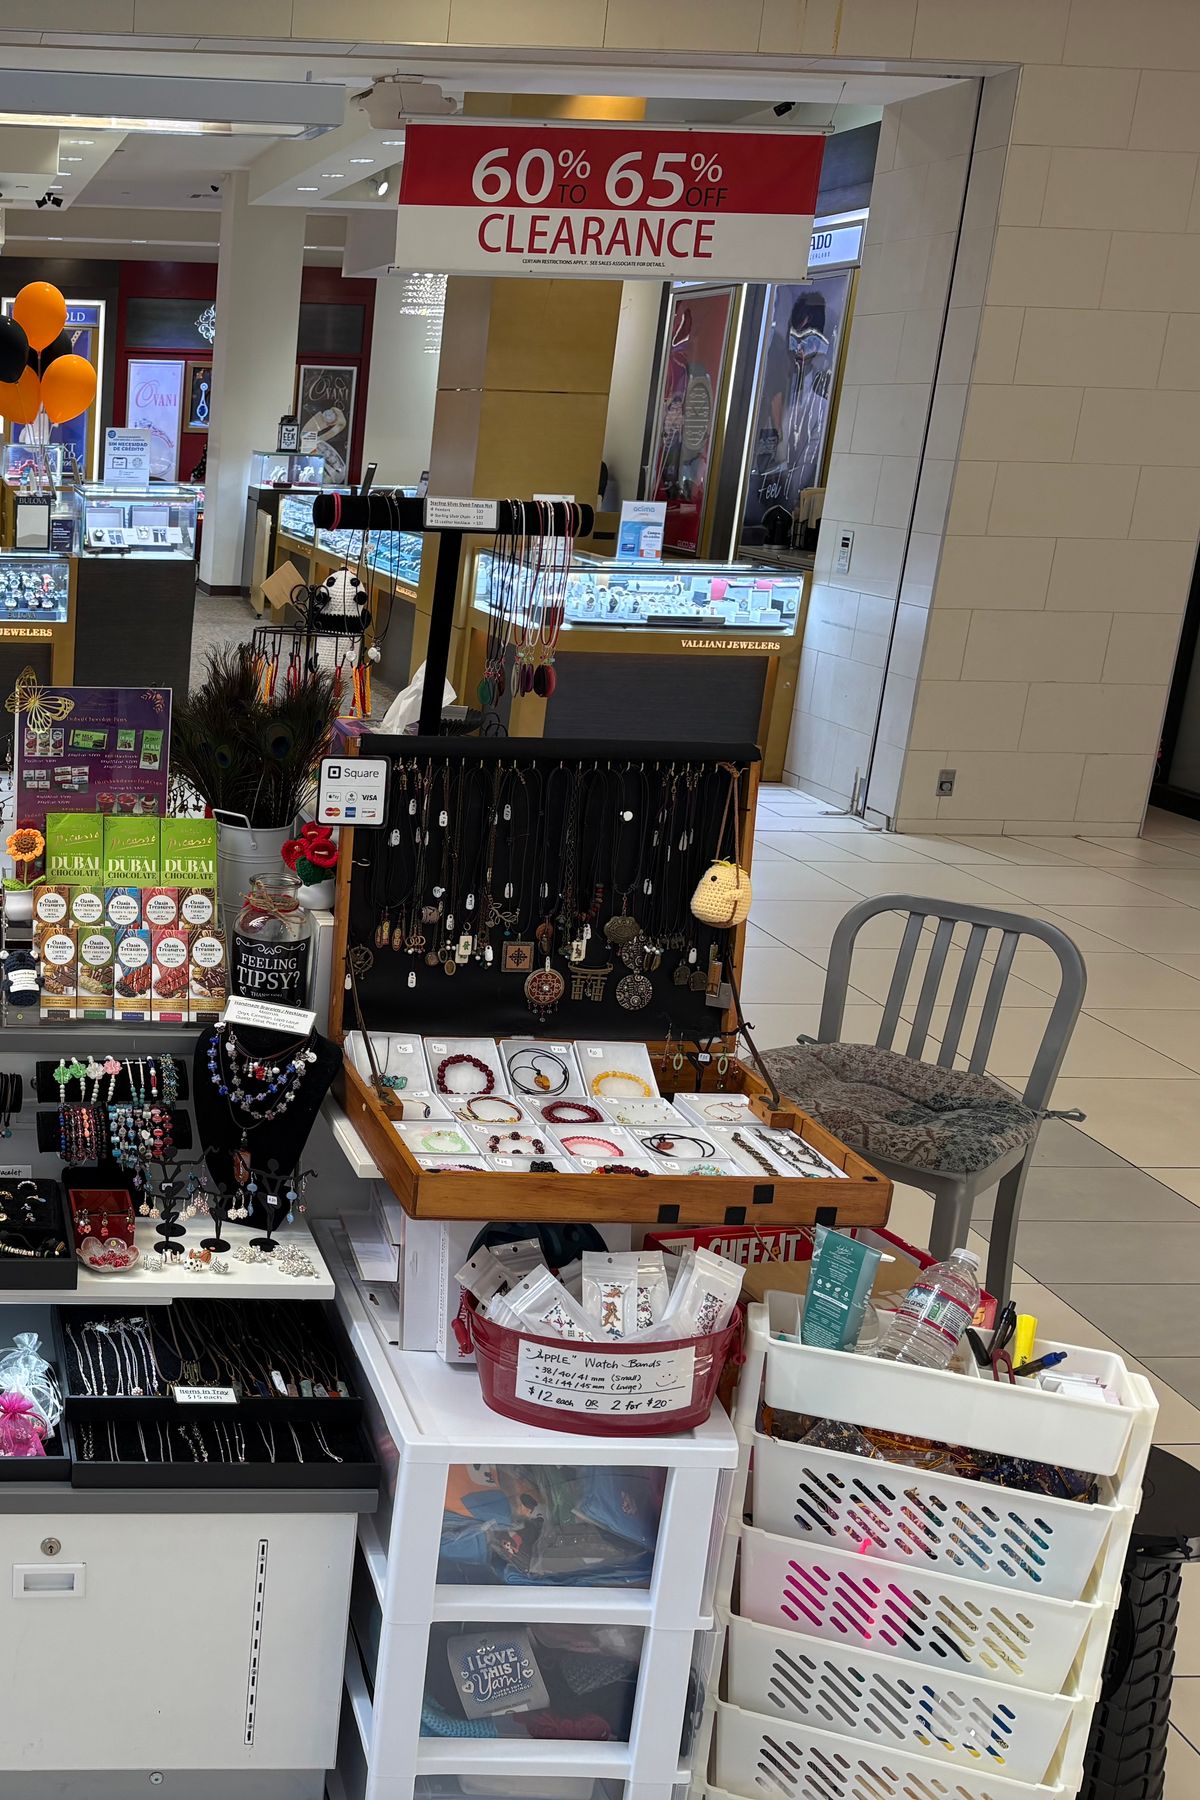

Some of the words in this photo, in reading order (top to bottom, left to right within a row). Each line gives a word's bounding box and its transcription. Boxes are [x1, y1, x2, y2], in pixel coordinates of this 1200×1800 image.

[472, 147, 591, 206] 60%
[605, 151, 724, 207] 65%
[558, 184, 587, 204] TO
[685, 186, 728, 207] OFF
[478, 213, 715, 258] CLEARANCE
[283, 432, 297, 441] EEK
[758, 470, 783, 503] Feel
[19, 497, 48, 505] BULOVA
[0, 627, 53, 637] JEWELERS
[681, 639, 727, 649] VALLIANI
[727, 640, 781, 650] JEWELERS
[344, 768, 380, 780] Square
[51, 856, 100, 870] DUBAI
[108, 859, 157, 873] DUBAI
[165, 859, 214, 873] DUBAI
[51, 869, 100, 877] CHOCOLATE
[108, 872, 157, 880] CHOCOLATE
[165, 872, 214, 881] CHOCOLATE
[241, 953, 297, 970] FEELING
[236, 965, 300, 990] TIPSY?
[585, 1357, 619, 1369] Watch
[622, 1358, 661, 1369] Bands
[541, 1366, 588, 1380] 38/40/41
[611, 1374, 642, 1383] (Small)
[542, 1376, 591, 1390] 42/44/45
[611, 1383, 643, 1394] (Large)
[528, 1386, 553, 1403] $12
[556, 1397, 575, 1408] each
[585, 1399, 598, 1409] OR
[611, 1399, 621, 1411] 2
[625, 1400, 643, 1412] for
[467, 1656, 475, 1671] I
[480, 1663, 513, 1680] THIS
[472, 1661, 522, 1702] Yarn!
